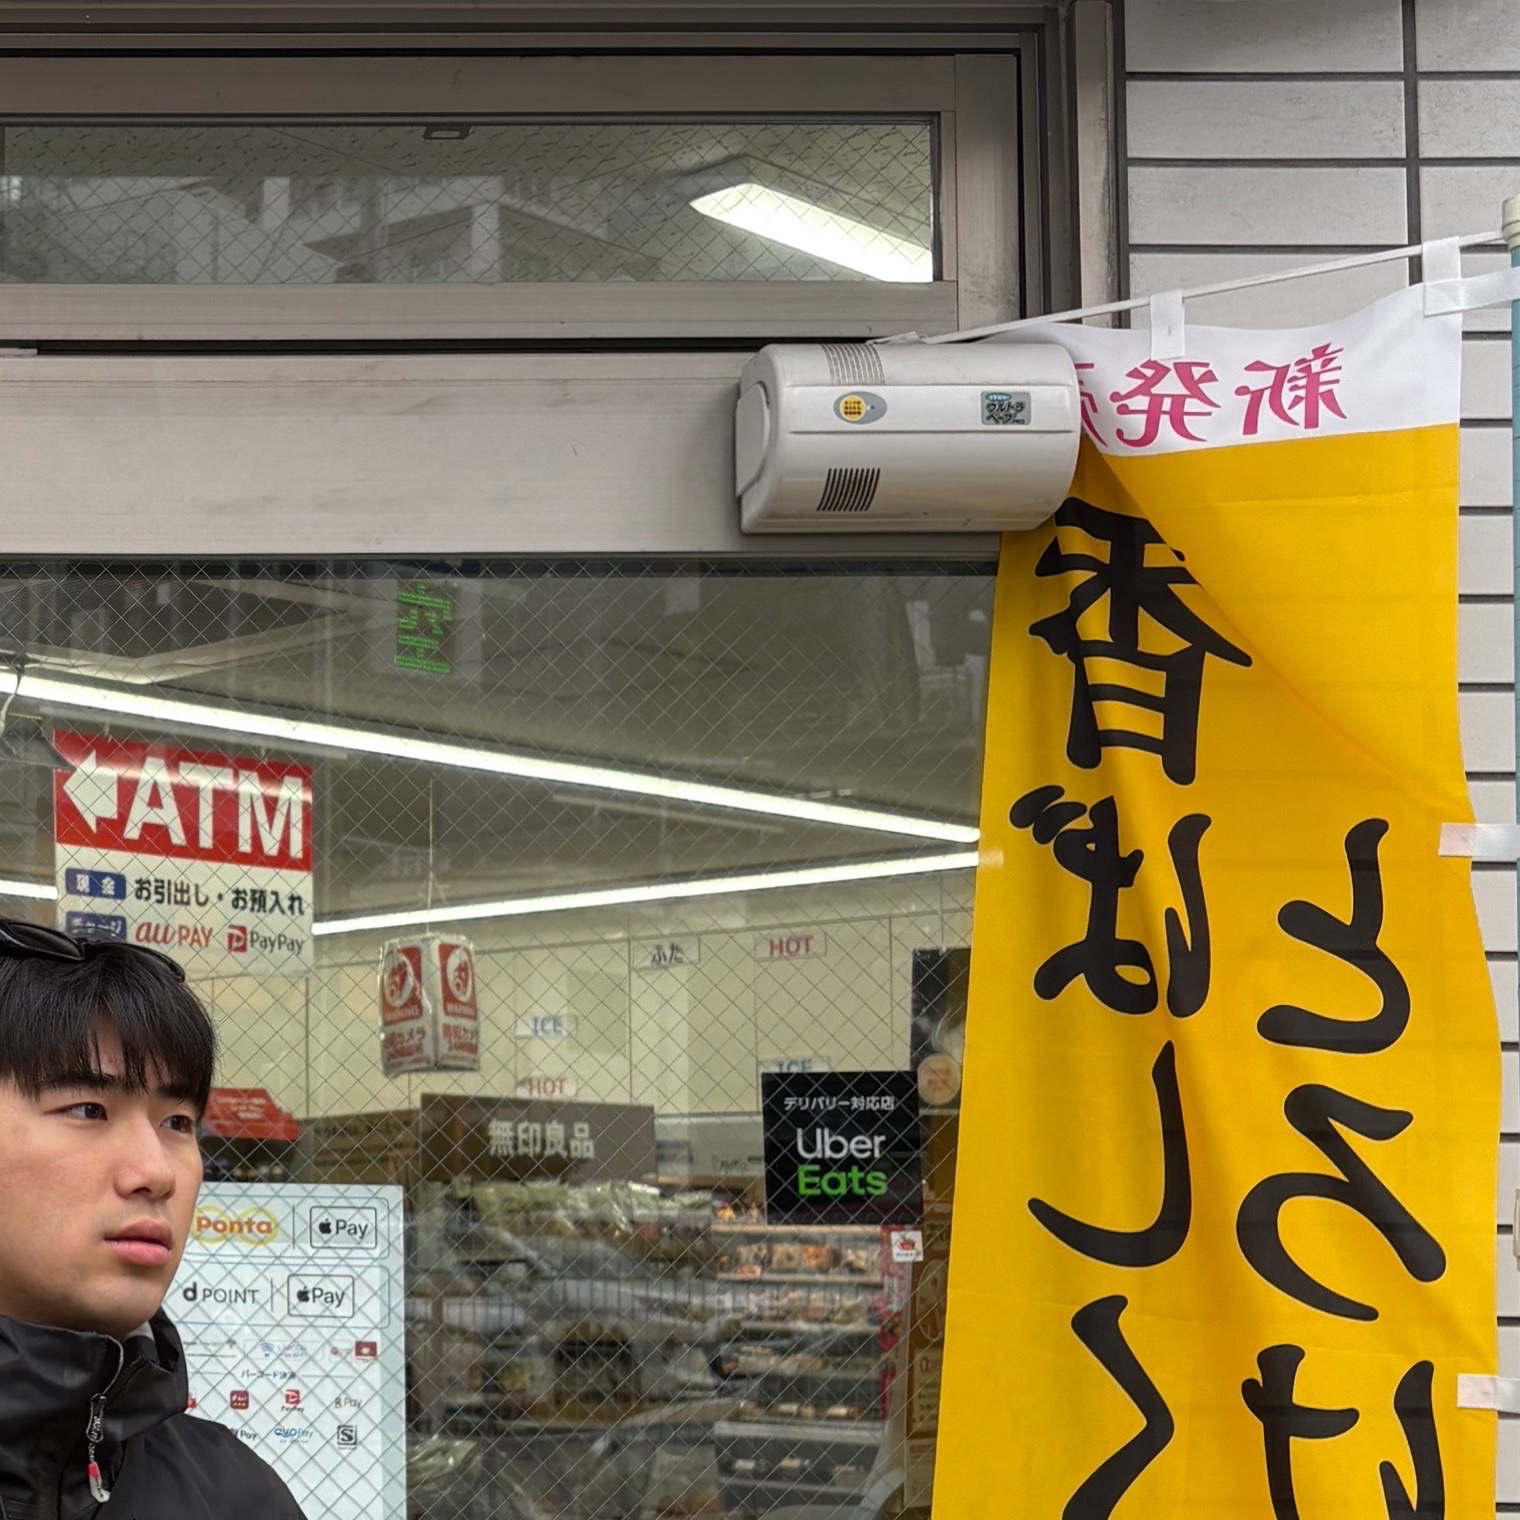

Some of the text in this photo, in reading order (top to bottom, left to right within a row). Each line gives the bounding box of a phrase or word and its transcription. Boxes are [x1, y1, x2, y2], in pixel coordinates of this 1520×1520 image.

[986, 402, 1024, 412] ウルトラ
[123, 757, 303, 860] ATM
[76, 873, 116, 896] 現金
[134, 878, 305, 916] お引出し・お預入れ
[135, 921, 214, 948] au PAY
[250, 932, 305, 954] PayPay
[769, 935, 813, 957] HOT
[533, 1016, 563, 1035] ICE
[528, 1077, 569, 1096] HOT
[783, 1096, 895, 1111] デリバリー対応店
[488, 1117, 596, 1159] 無印良品
[796, 1128, 886, 1160] Uber
[798, 1164, 889, 1197] Eats
[196, 1216, 273, 1236] Ponta
[335, 1219, 370, 1241] Pay
[202, 1289, 260, 1305] POINT
[311, 1286, 346, 1307] Pay
